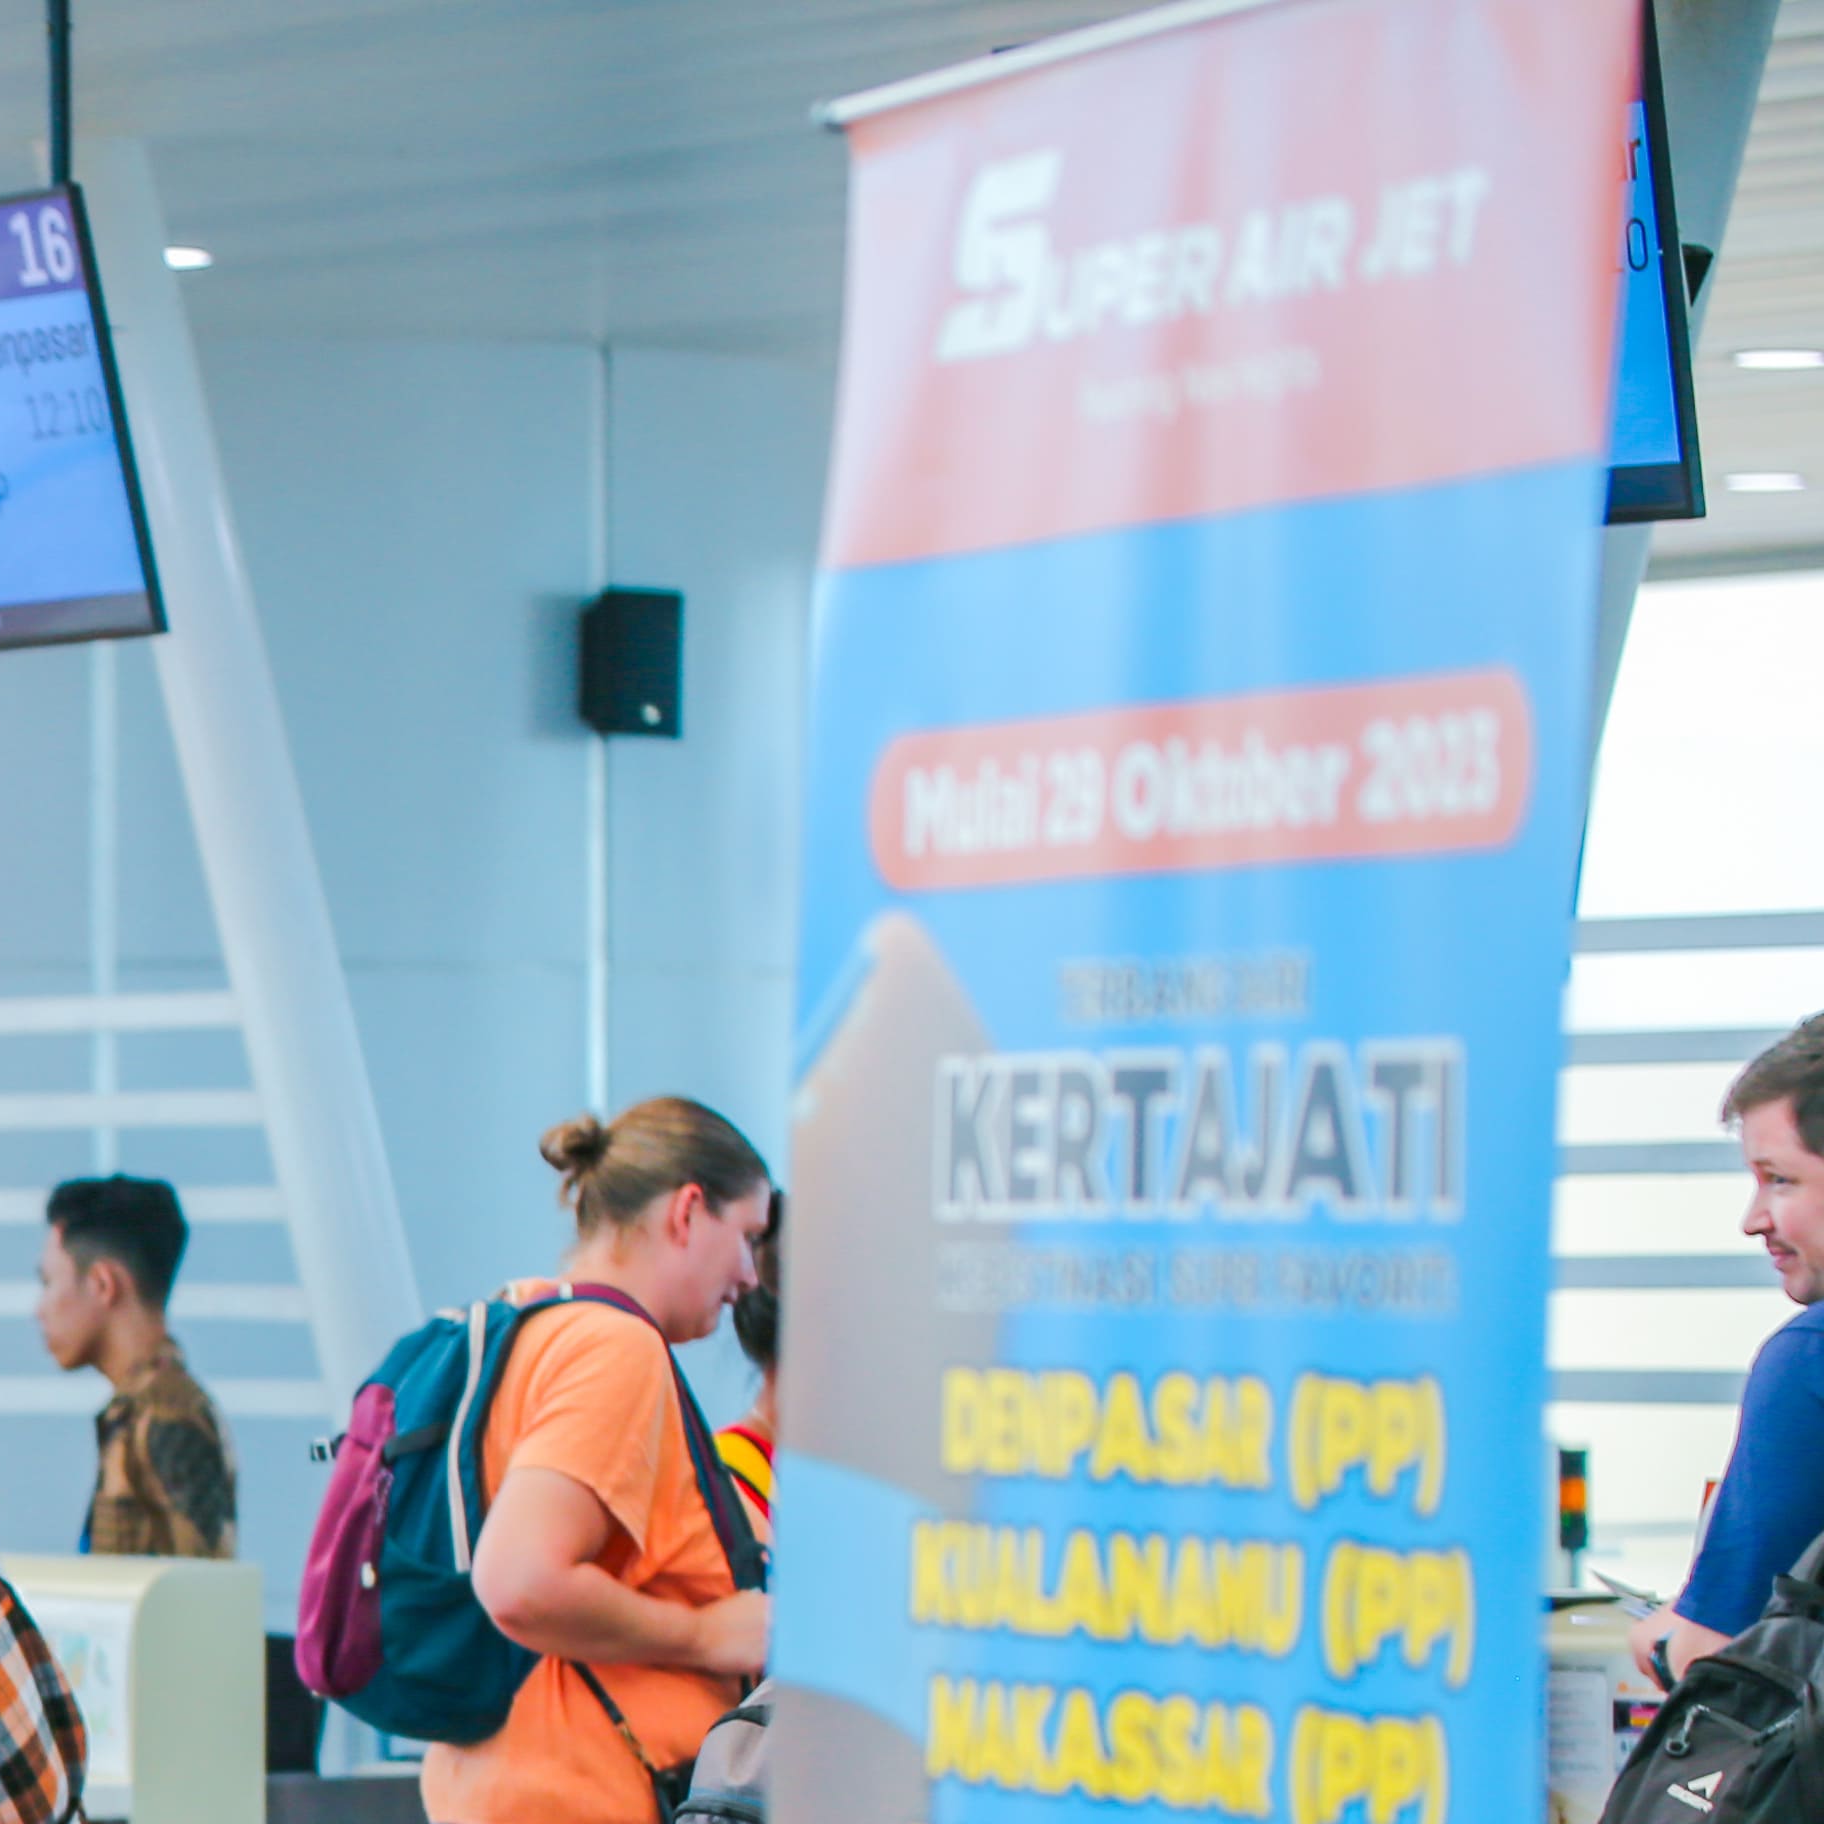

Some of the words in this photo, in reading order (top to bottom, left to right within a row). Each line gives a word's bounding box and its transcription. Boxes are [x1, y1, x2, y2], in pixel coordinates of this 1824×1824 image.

[9, 206, 75, 287] 16
[936, 147, 1221, 363] SUPER
[1230, 195, 1352, 309] AIR
[1361, 165, 1490, 283] JET
[25, 390, 107, 440] 12:10
[903, 754, 1039, 856] Mulai
[1045, 746, 1104, 846] 29
[1112, 730, 1347, 841] Oktober
[1360, 708, 1502, 822] 2023
[935, 1038, 1463, 1220] KERTAJATI
[942, 1368, 1272, 1488] DENPASAR
[1288, 1370, 1446, 1514] (PP)
[912, 1520, 1303, 1657] KUALANAMU
[1322, 1540, 1475, 1688] (PP)
[927, 1674, 1272, 1817] MAKASSAR
